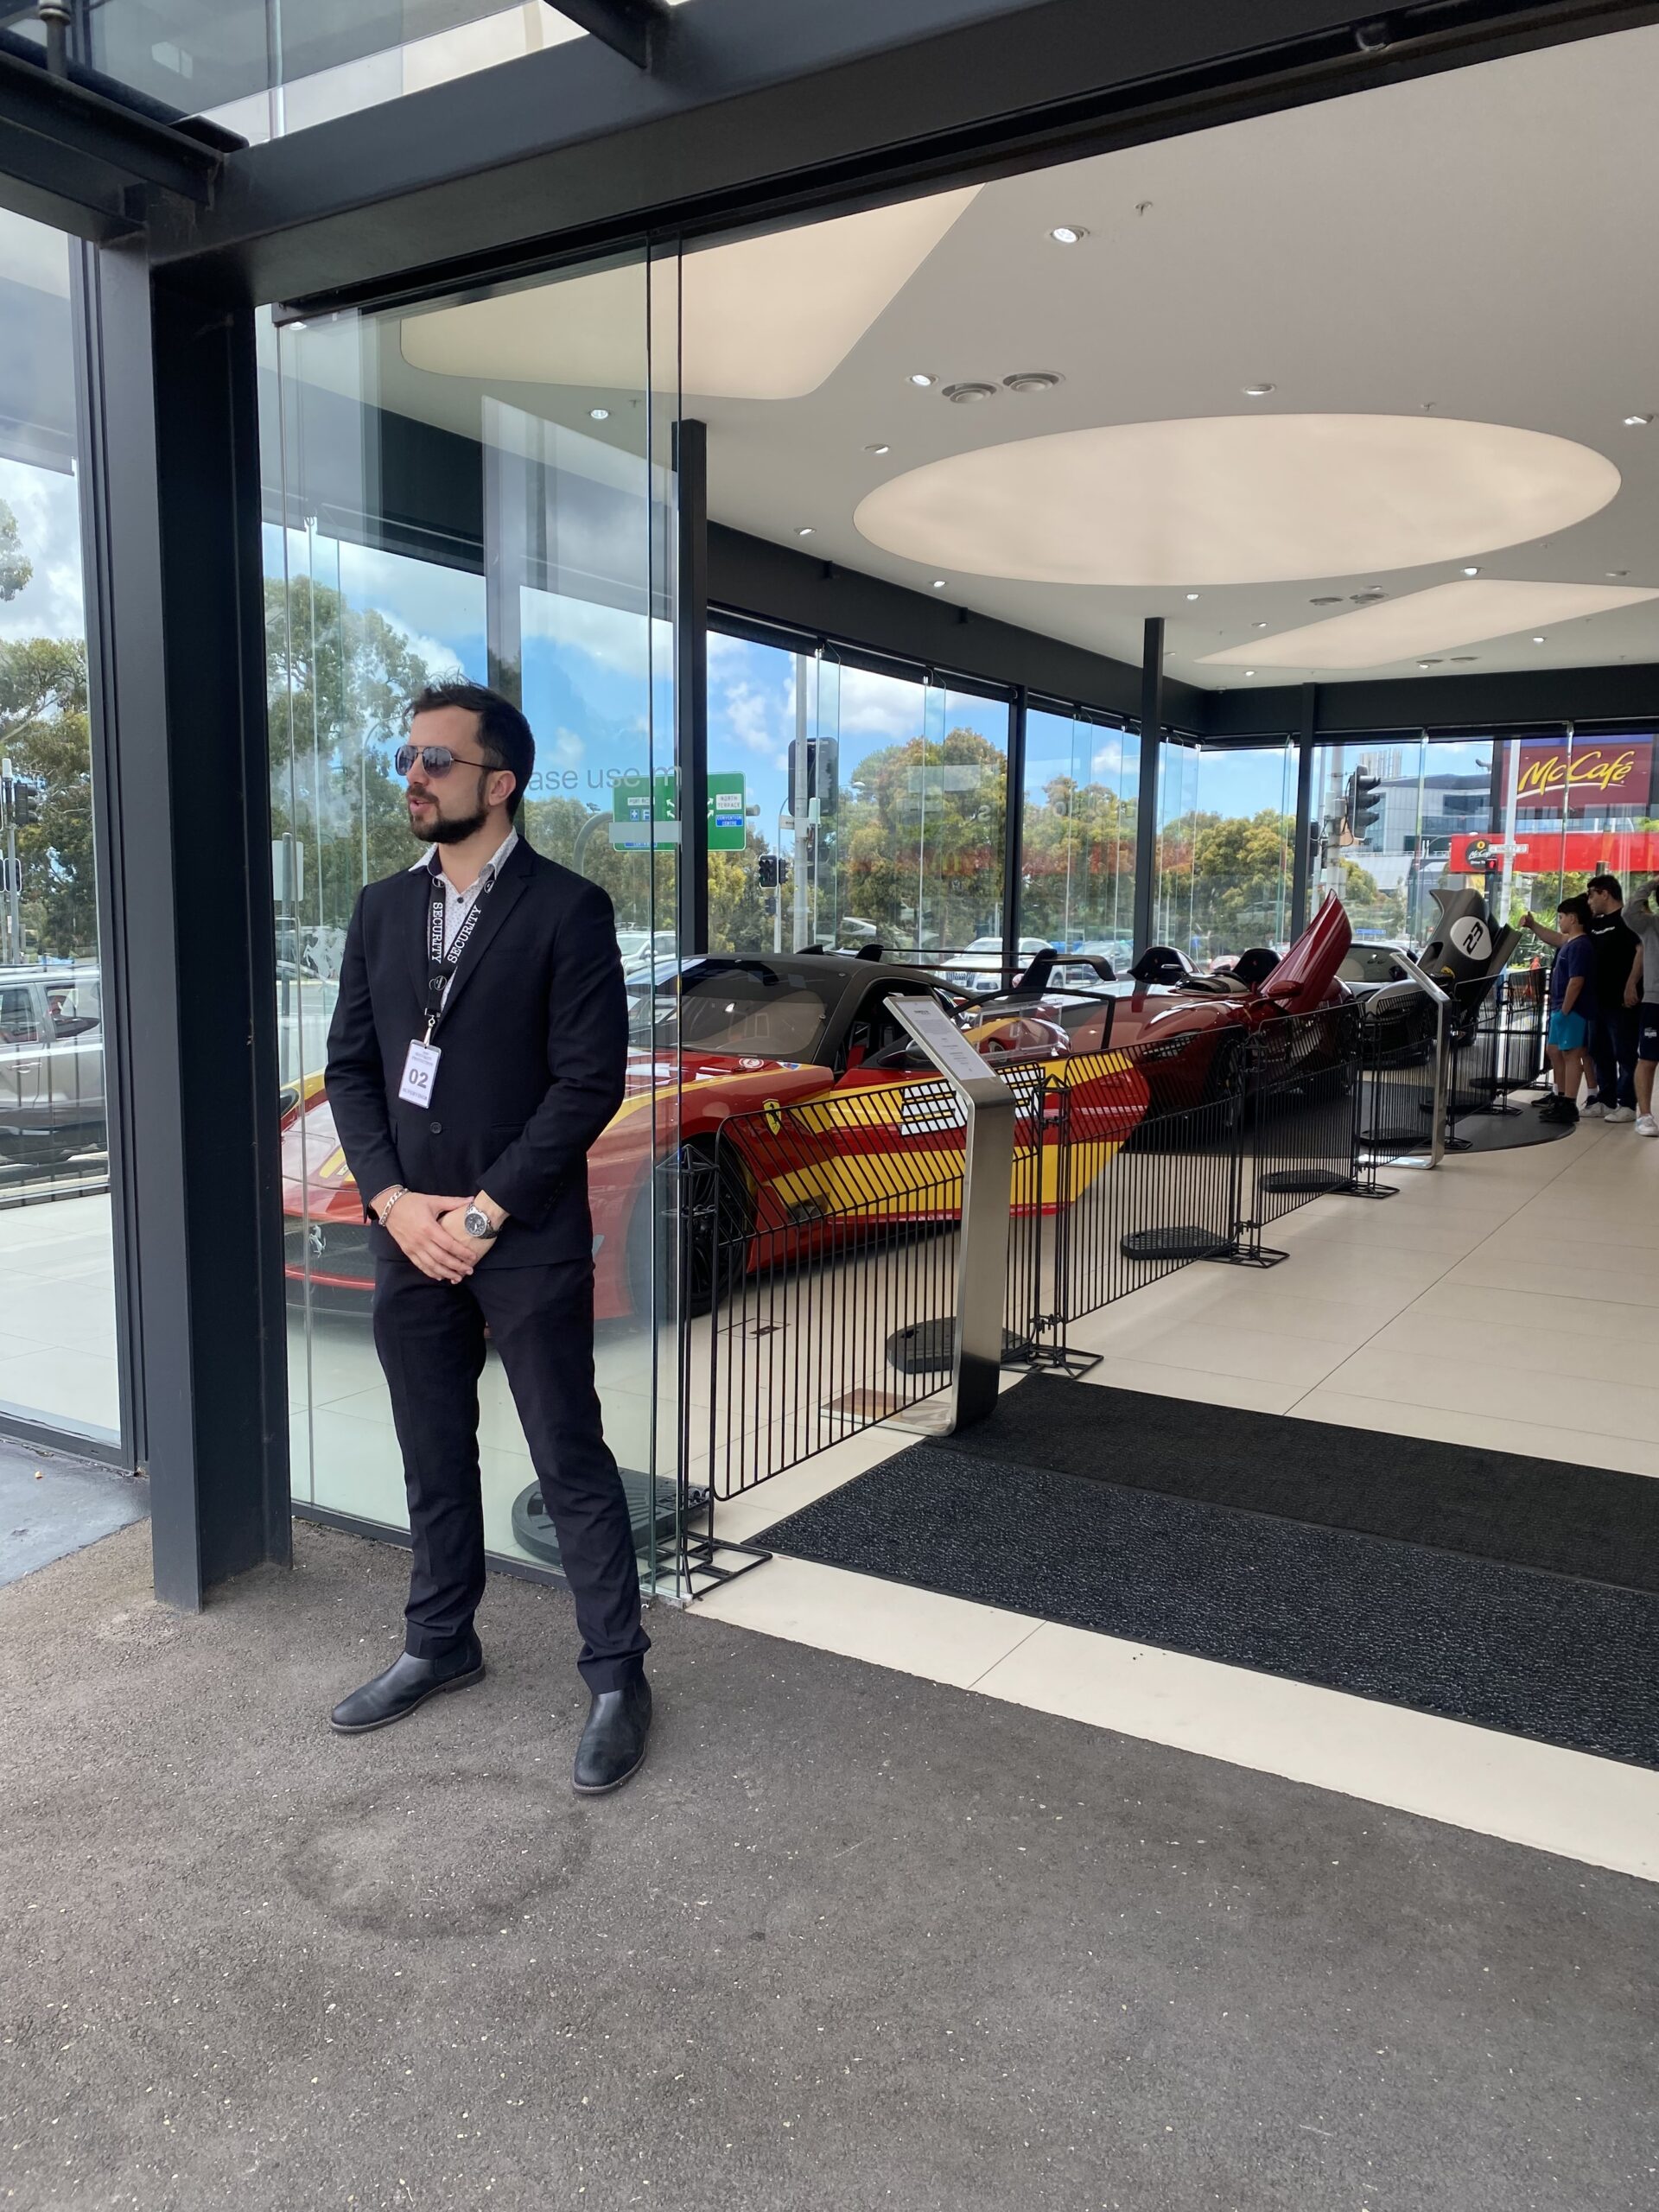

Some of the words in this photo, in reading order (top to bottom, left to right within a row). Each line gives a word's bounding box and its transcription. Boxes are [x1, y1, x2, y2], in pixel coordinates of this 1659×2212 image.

[528, 768, 578, 791] ase
[587, 766, 640, 790] use
[1518, 750, 1635, 796] McCafé
[432, 902, 443, 964] SECURITY
[447, 905, 481, 964] SECURITY
[1463, 921, 1484, 955] 23
[409, 1068, 429, 1089] 02
